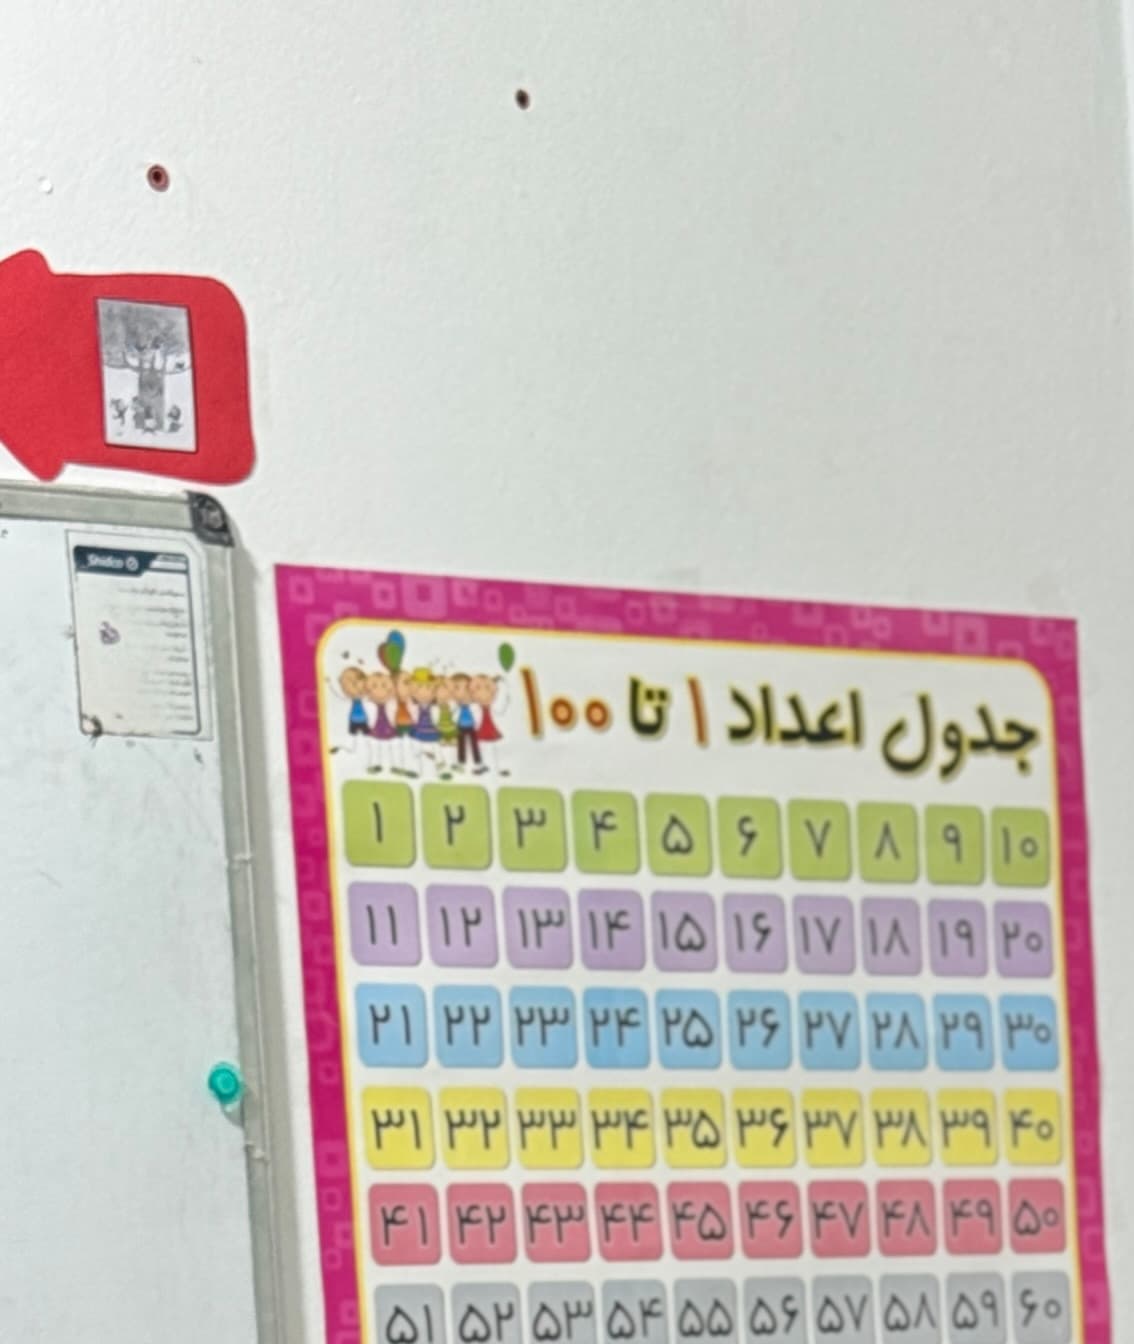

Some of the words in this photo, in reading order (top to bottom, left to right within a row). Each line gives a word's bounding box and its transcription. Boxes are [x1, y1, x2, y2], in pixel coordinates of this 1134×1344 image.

[521, 668, 609, 739] ۱۰۰
[629, 677, 671, 739] تا
[688, 679, 707, 745] ۱
[728, 686, 865, 747] اعداد
[881, 694, 1039, 782] جدول
[372, 801, 384, 844] ۱
[443, 804, 466, 846] ۲
[512, 807, 548, 849] ۳
[589, 809, 618, 851] ۴
[660, 814, 695, 856] ۵
[737, 815, 759, 857] ۶
[803, 818, 832, 859] ۷
[873, 820, 902, 861] ۸
[942, 822, 963, 864] ۹
[1001, 826, 1039, 866] ۱۰
[365, 904, 399, 946] ۱۱
[439, 906, 483, 948] ۱۲
[517, 908, 567, 950] ۱۳
[588, 909, 631, 950] ۱۴
[658, 911, 708, 953] ۱۵
[733, 911, 773, 953] ۱۶
[798, 915, 842, 956] ۱۷
[867, 916, 911, 957] ۱۸
[938, 918, 975, 958] ۱۹
[1000, 920, 1044, 960] ۲۰
[368, 1003, 412, 1046] ۲۱
[443, 1005, 492, 1047] ۲۲
[513, 1006, 571, 1047] ۲۳
[588, 1006, 641, 1048] ۲۴
[661, 1007, 715, 1049] ۲۵
[735, 1006, 781, 1048] ۲۶
[802, 1010, 853, 1050] ۲۷
[870, 1010, 920, 1051] ۲۸
[939, 1010, 985, 1051] ۲۹
[1003, 1013, 1055, 1051] ۳۰
[370, 1108, 422, 1151] ۳۱
[443, 1109, 502, 1151] ۳۲
[515, 1109, 578, 1151] ۳۳
[589, 1108, 650, 1151] ۳۴
[663, 1108, 722, 1150] ۳۵
[735, 1106, 790, 1148] ۳۶
[803, 1109, 859, 1150] ۳۷
[872, 1109, 928, 1150] ۳۸
[939, 1108, 992, 1149] ۳۹
[1008, 1108, 1055, 1148] ۴۰
[380, 1204, 428, 1246] ۴۱
[455, 1203, 507, 1244] ۴۲
[524, 1203, 587, 1244] ۴۳
[599, 1202, 655, 1243] ۴۴
[671, 1200, 728, 1242] ۴۵
[745, 1199, 795, 1239] ۴۶
[810, 1200, 865, 1239] ۴۷
[880, 1199, 932, 1238] ۴۸
[948, 1198, 996, 1237] ۴۹
[1011, 1198, 1062, 1237] ۵۰
[457, 1302, 515, 1344] ۵۲
[531, 1300, 593, 1343] ۵۳
[605, 1297, 664, 1341] ۵۴
[677, 1298, 735, 1339] ۵۵
[748, 1293, 800, 1337] ۵۶
[815, 1294, 868, 1335] ۵۷
[882, 1292, 938, 1333] ۵۸
[950, 1289, 999, 1331] ۵۹
[1018, 1287, 1063, 1328] ۶۰
